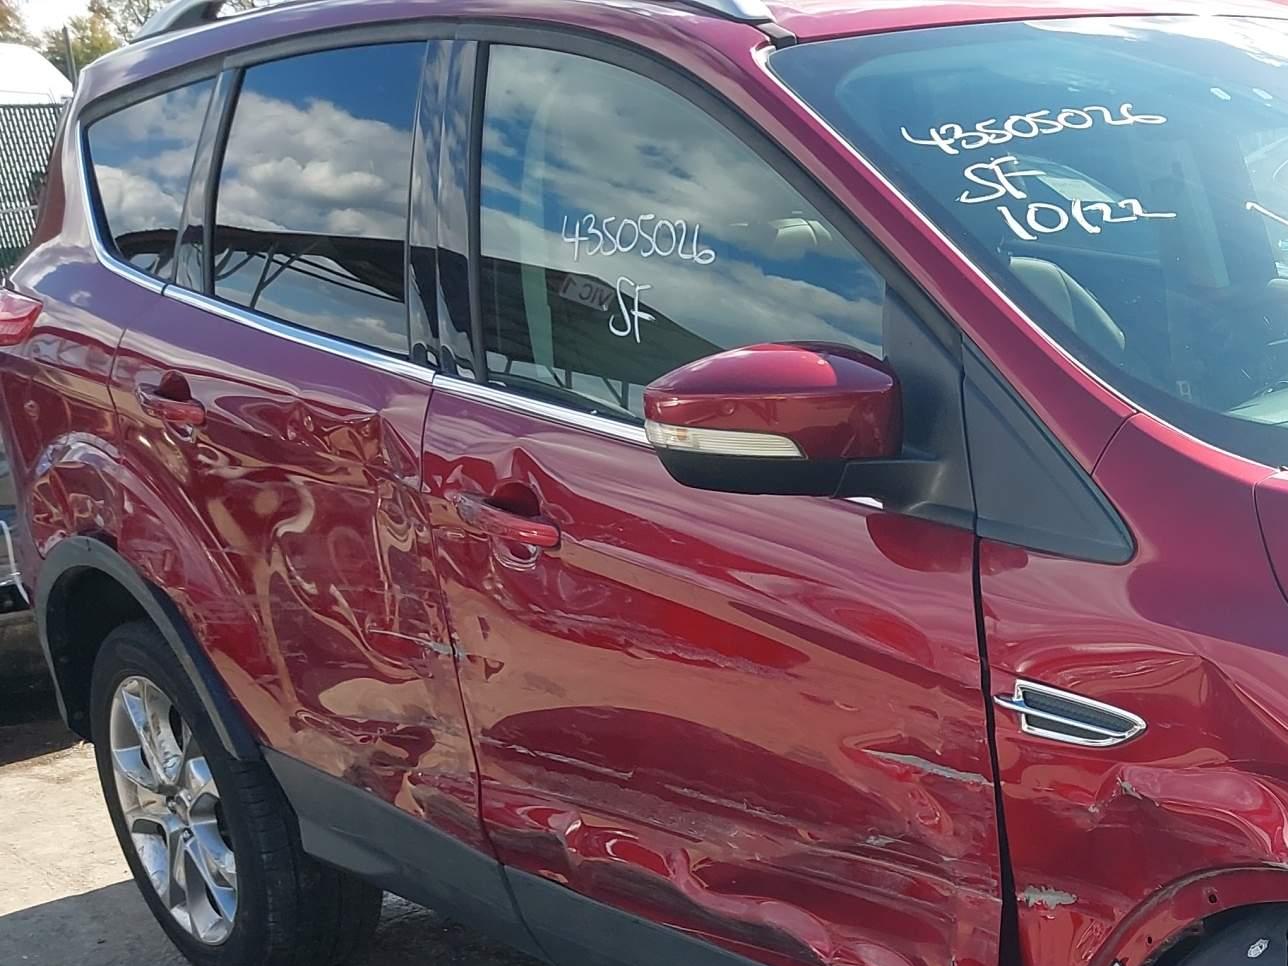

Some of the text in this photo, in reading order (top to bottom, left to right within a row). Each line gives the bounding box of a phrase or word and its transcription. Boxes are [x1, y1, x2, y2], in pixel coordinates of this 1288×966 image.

[901, 103, 1168, 155] 43505026
[956, 155, 1047, 204] SF
[562, 213, 716, 264] 43505026
[997, 198, 1177, 240] 10/22
[608, 276, 656, 344] SF
